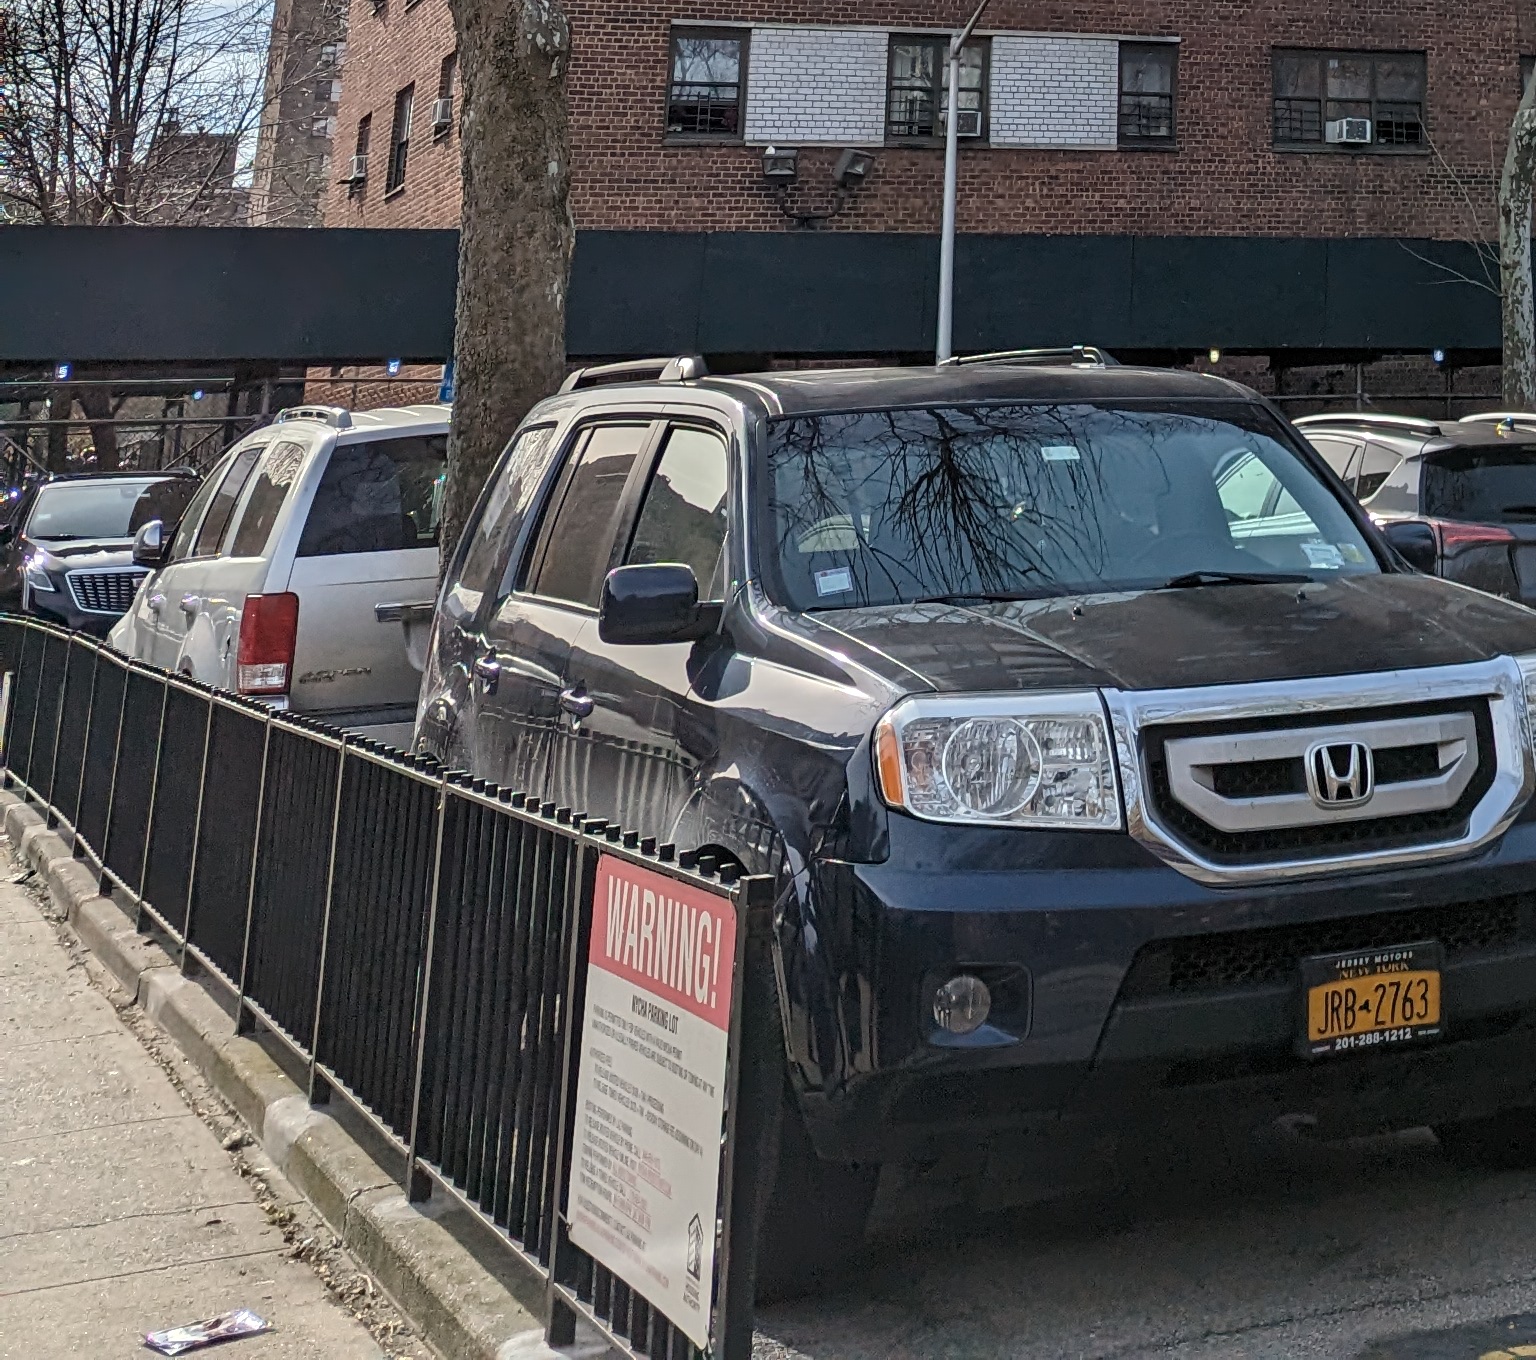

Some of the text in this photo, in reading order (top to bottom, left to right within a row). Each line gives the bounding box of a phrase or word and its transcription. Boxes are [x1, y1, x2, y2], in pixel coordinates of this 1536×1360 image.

[604, 873, 724, 1010] WARNING!
[1318, 978, 1430, 1035] JRB 2763
